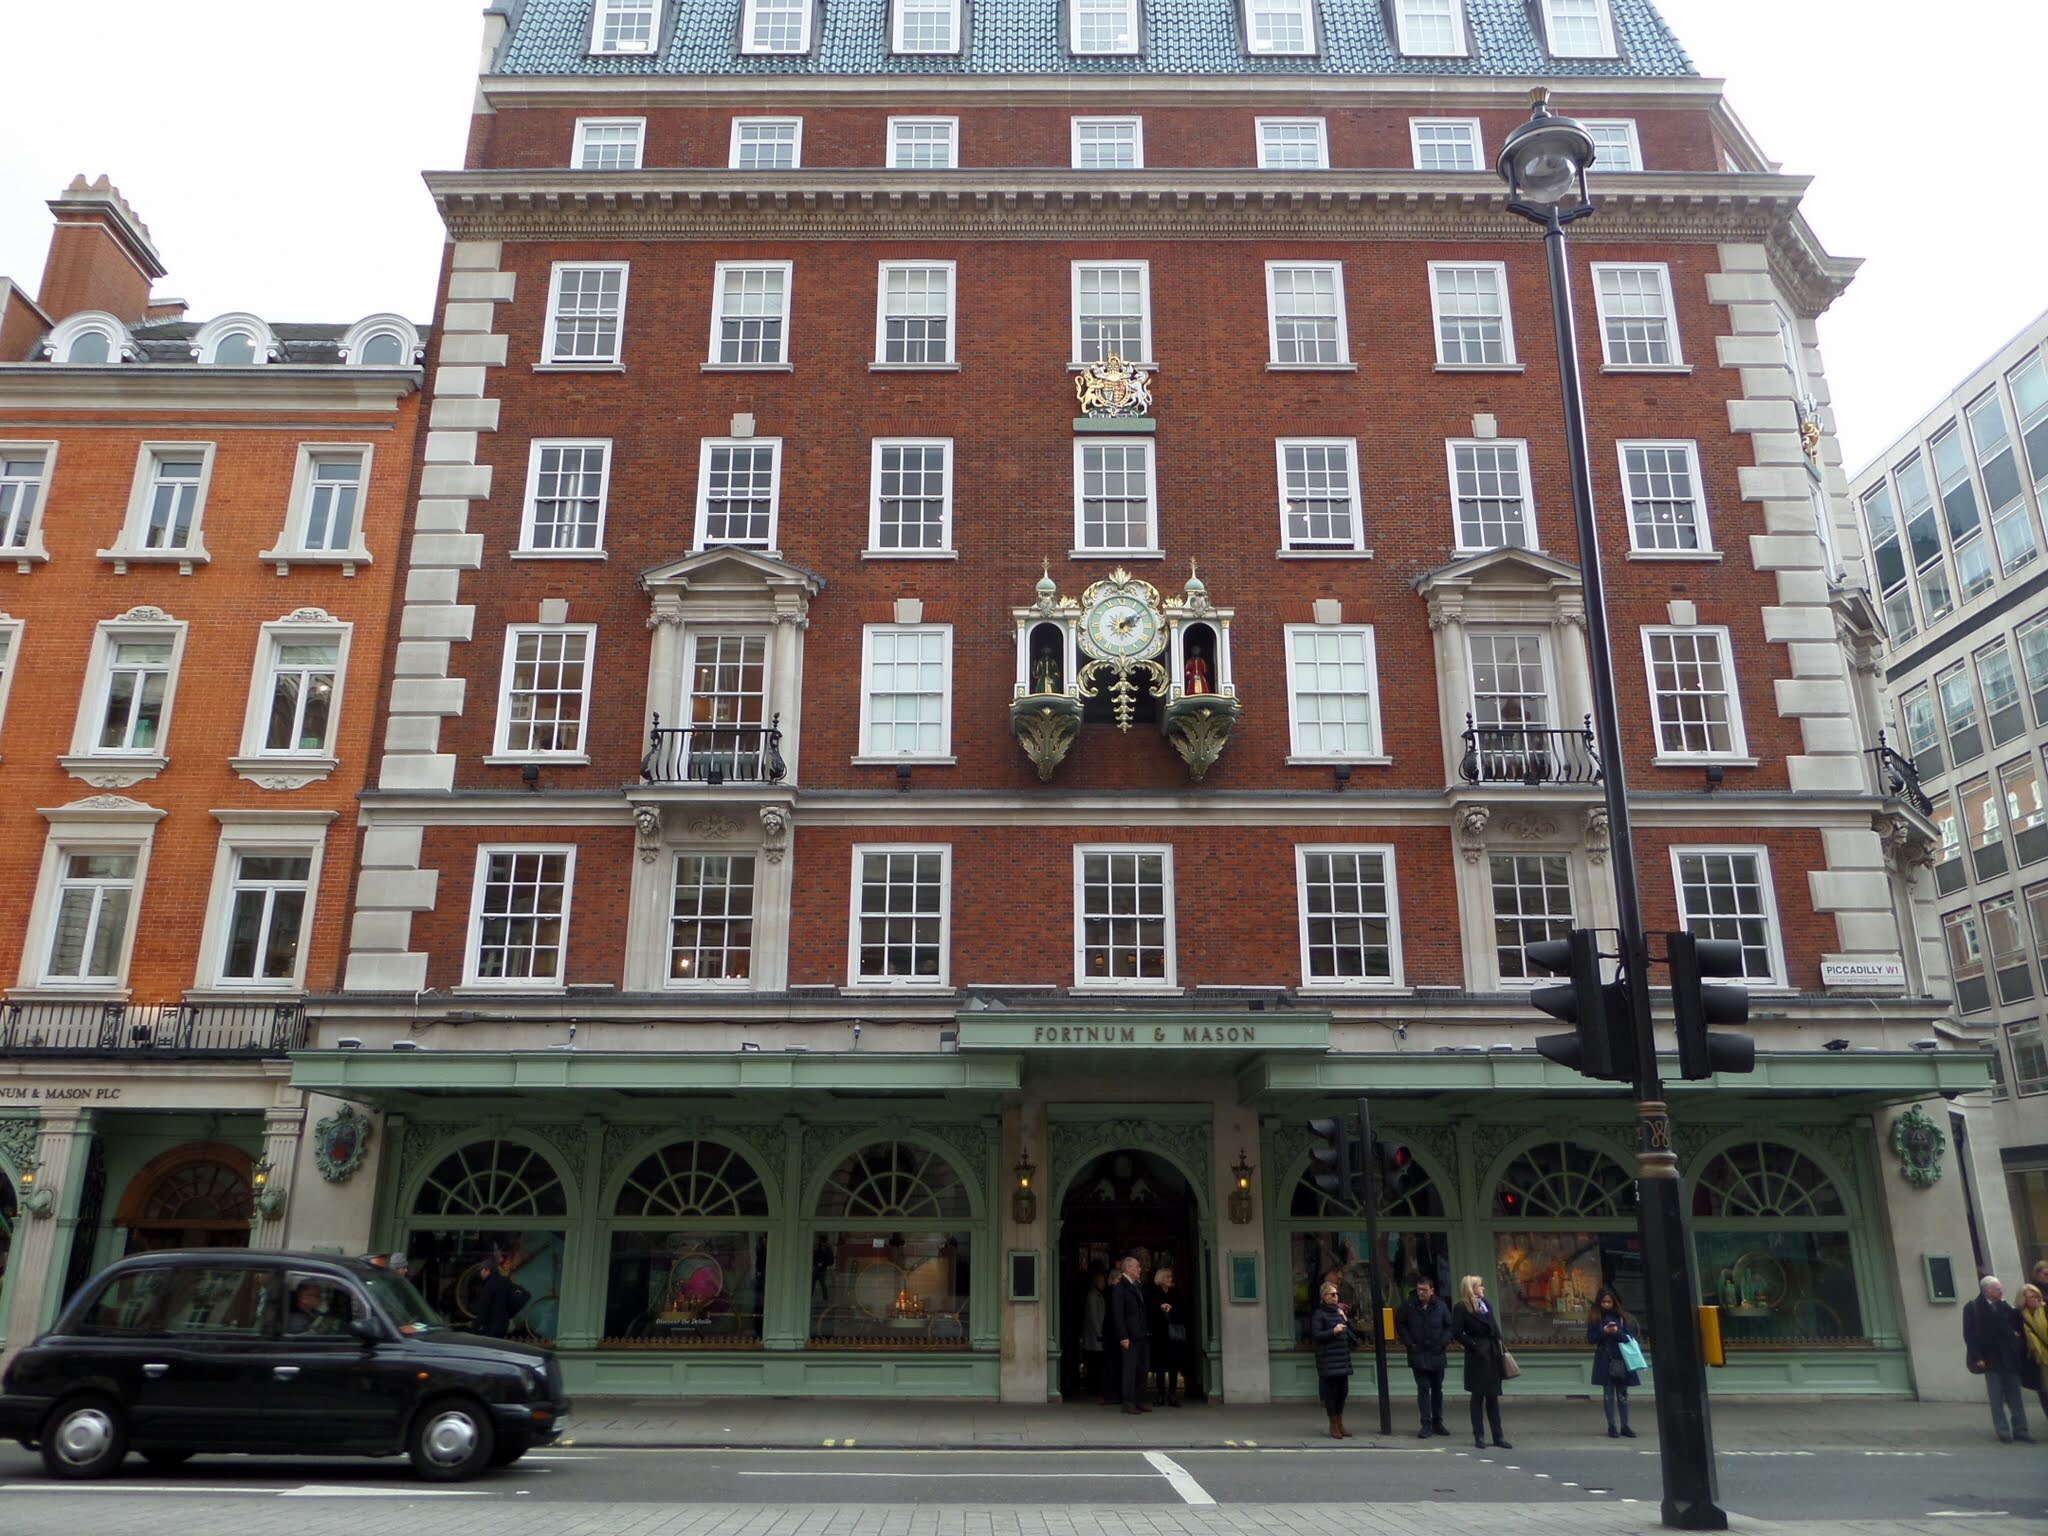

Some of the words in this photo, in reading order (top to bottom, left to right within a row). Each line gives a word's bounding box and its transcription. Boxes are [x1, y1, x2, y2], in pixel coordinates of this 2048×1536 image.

[1826, 966, 1882, 974] PICCADILLY
[1886, 966, 1899, 974] W1
[1035, 1027, 1135, 1041] FORTNUM
[1154, 1027, 1165, 1041] &
[1183, 1027, 1256, 1041] MASON
[31, 1088, 40, 1098] &
[45, 1088, 91, 1099] MASON
[96, 1088, 120, 1099] PLC
